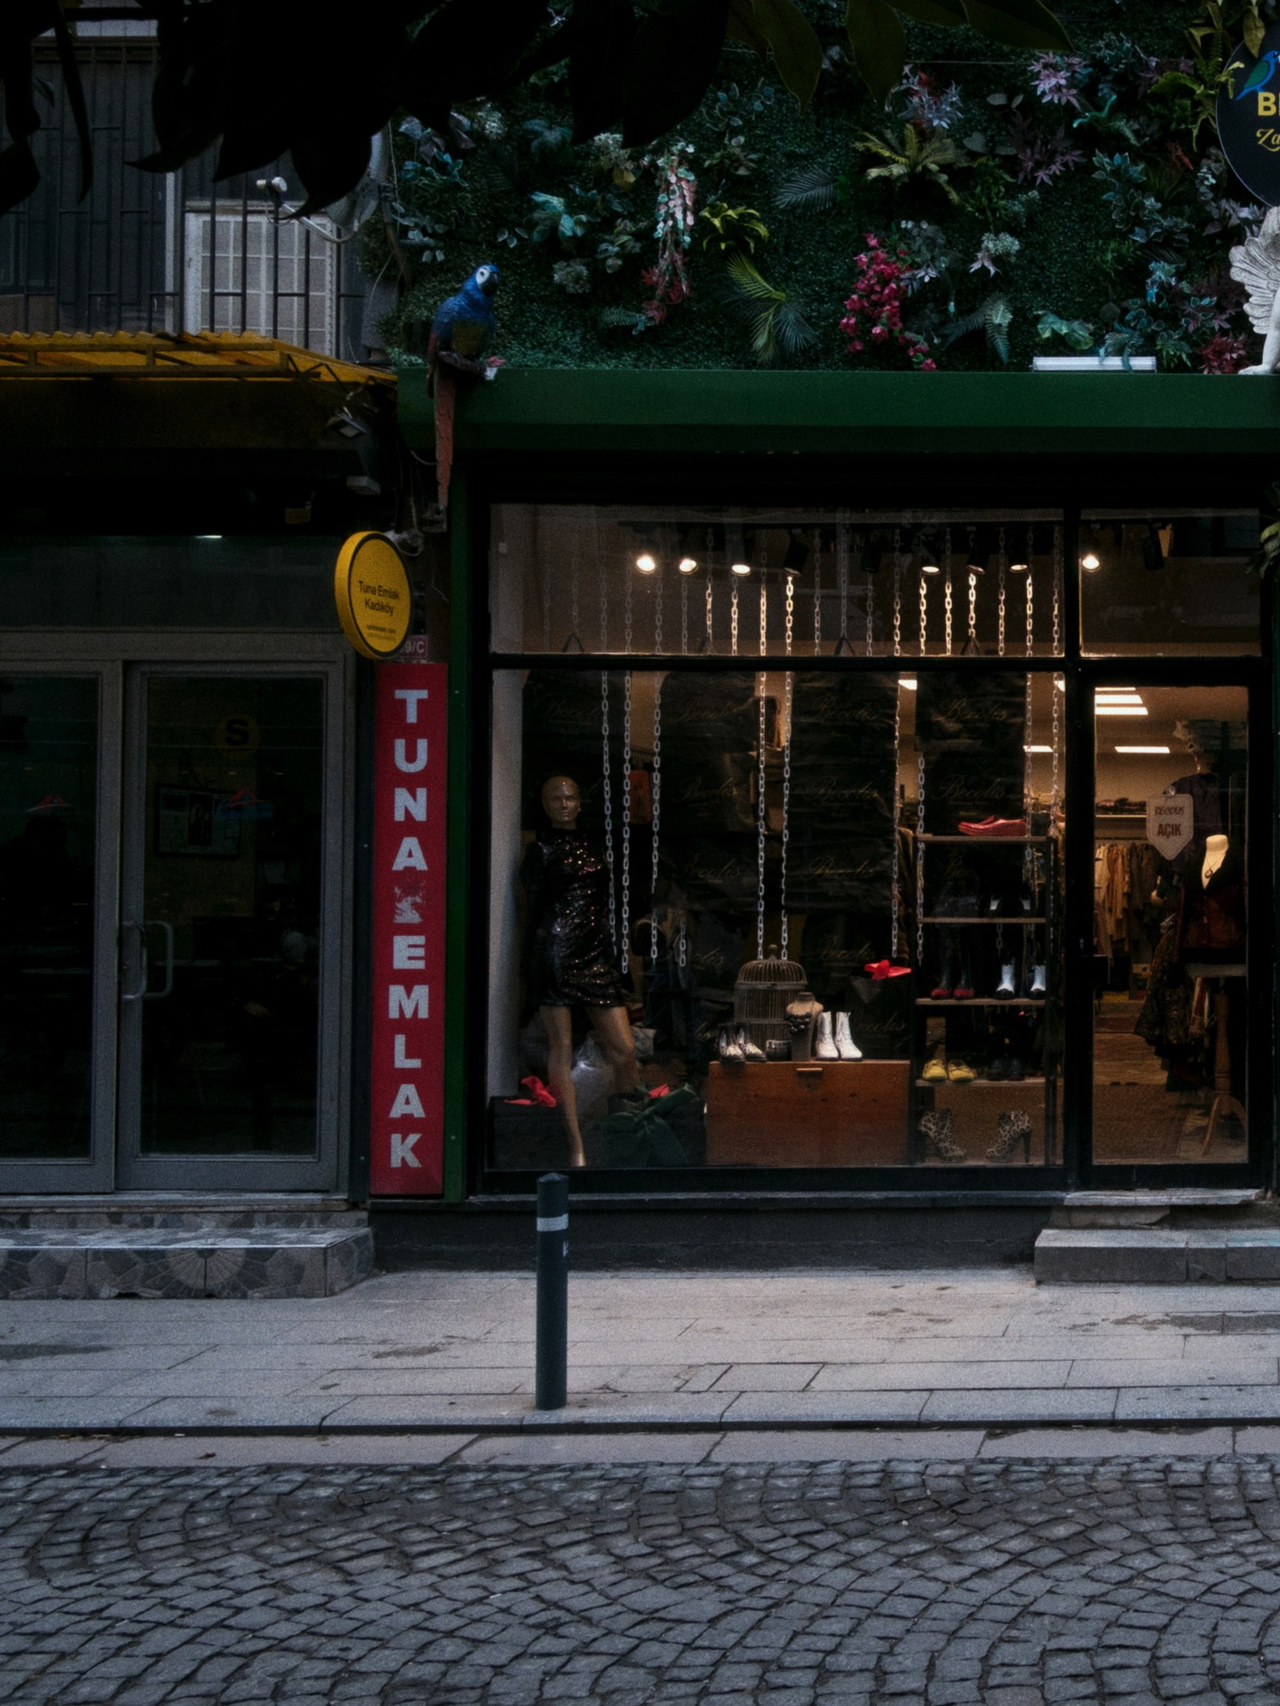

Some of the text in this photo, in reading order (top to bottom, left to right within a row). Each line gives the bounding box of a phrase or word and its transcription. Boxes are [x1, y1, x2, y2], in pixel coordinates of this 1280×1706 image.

[358, 580, 401, 600] Tuna Emlak
[225, 719, 250, 746] S
[1157, 823, 1182, 838] AÇIK
[388, 689, 430, 1168] TUNA EMLAK
